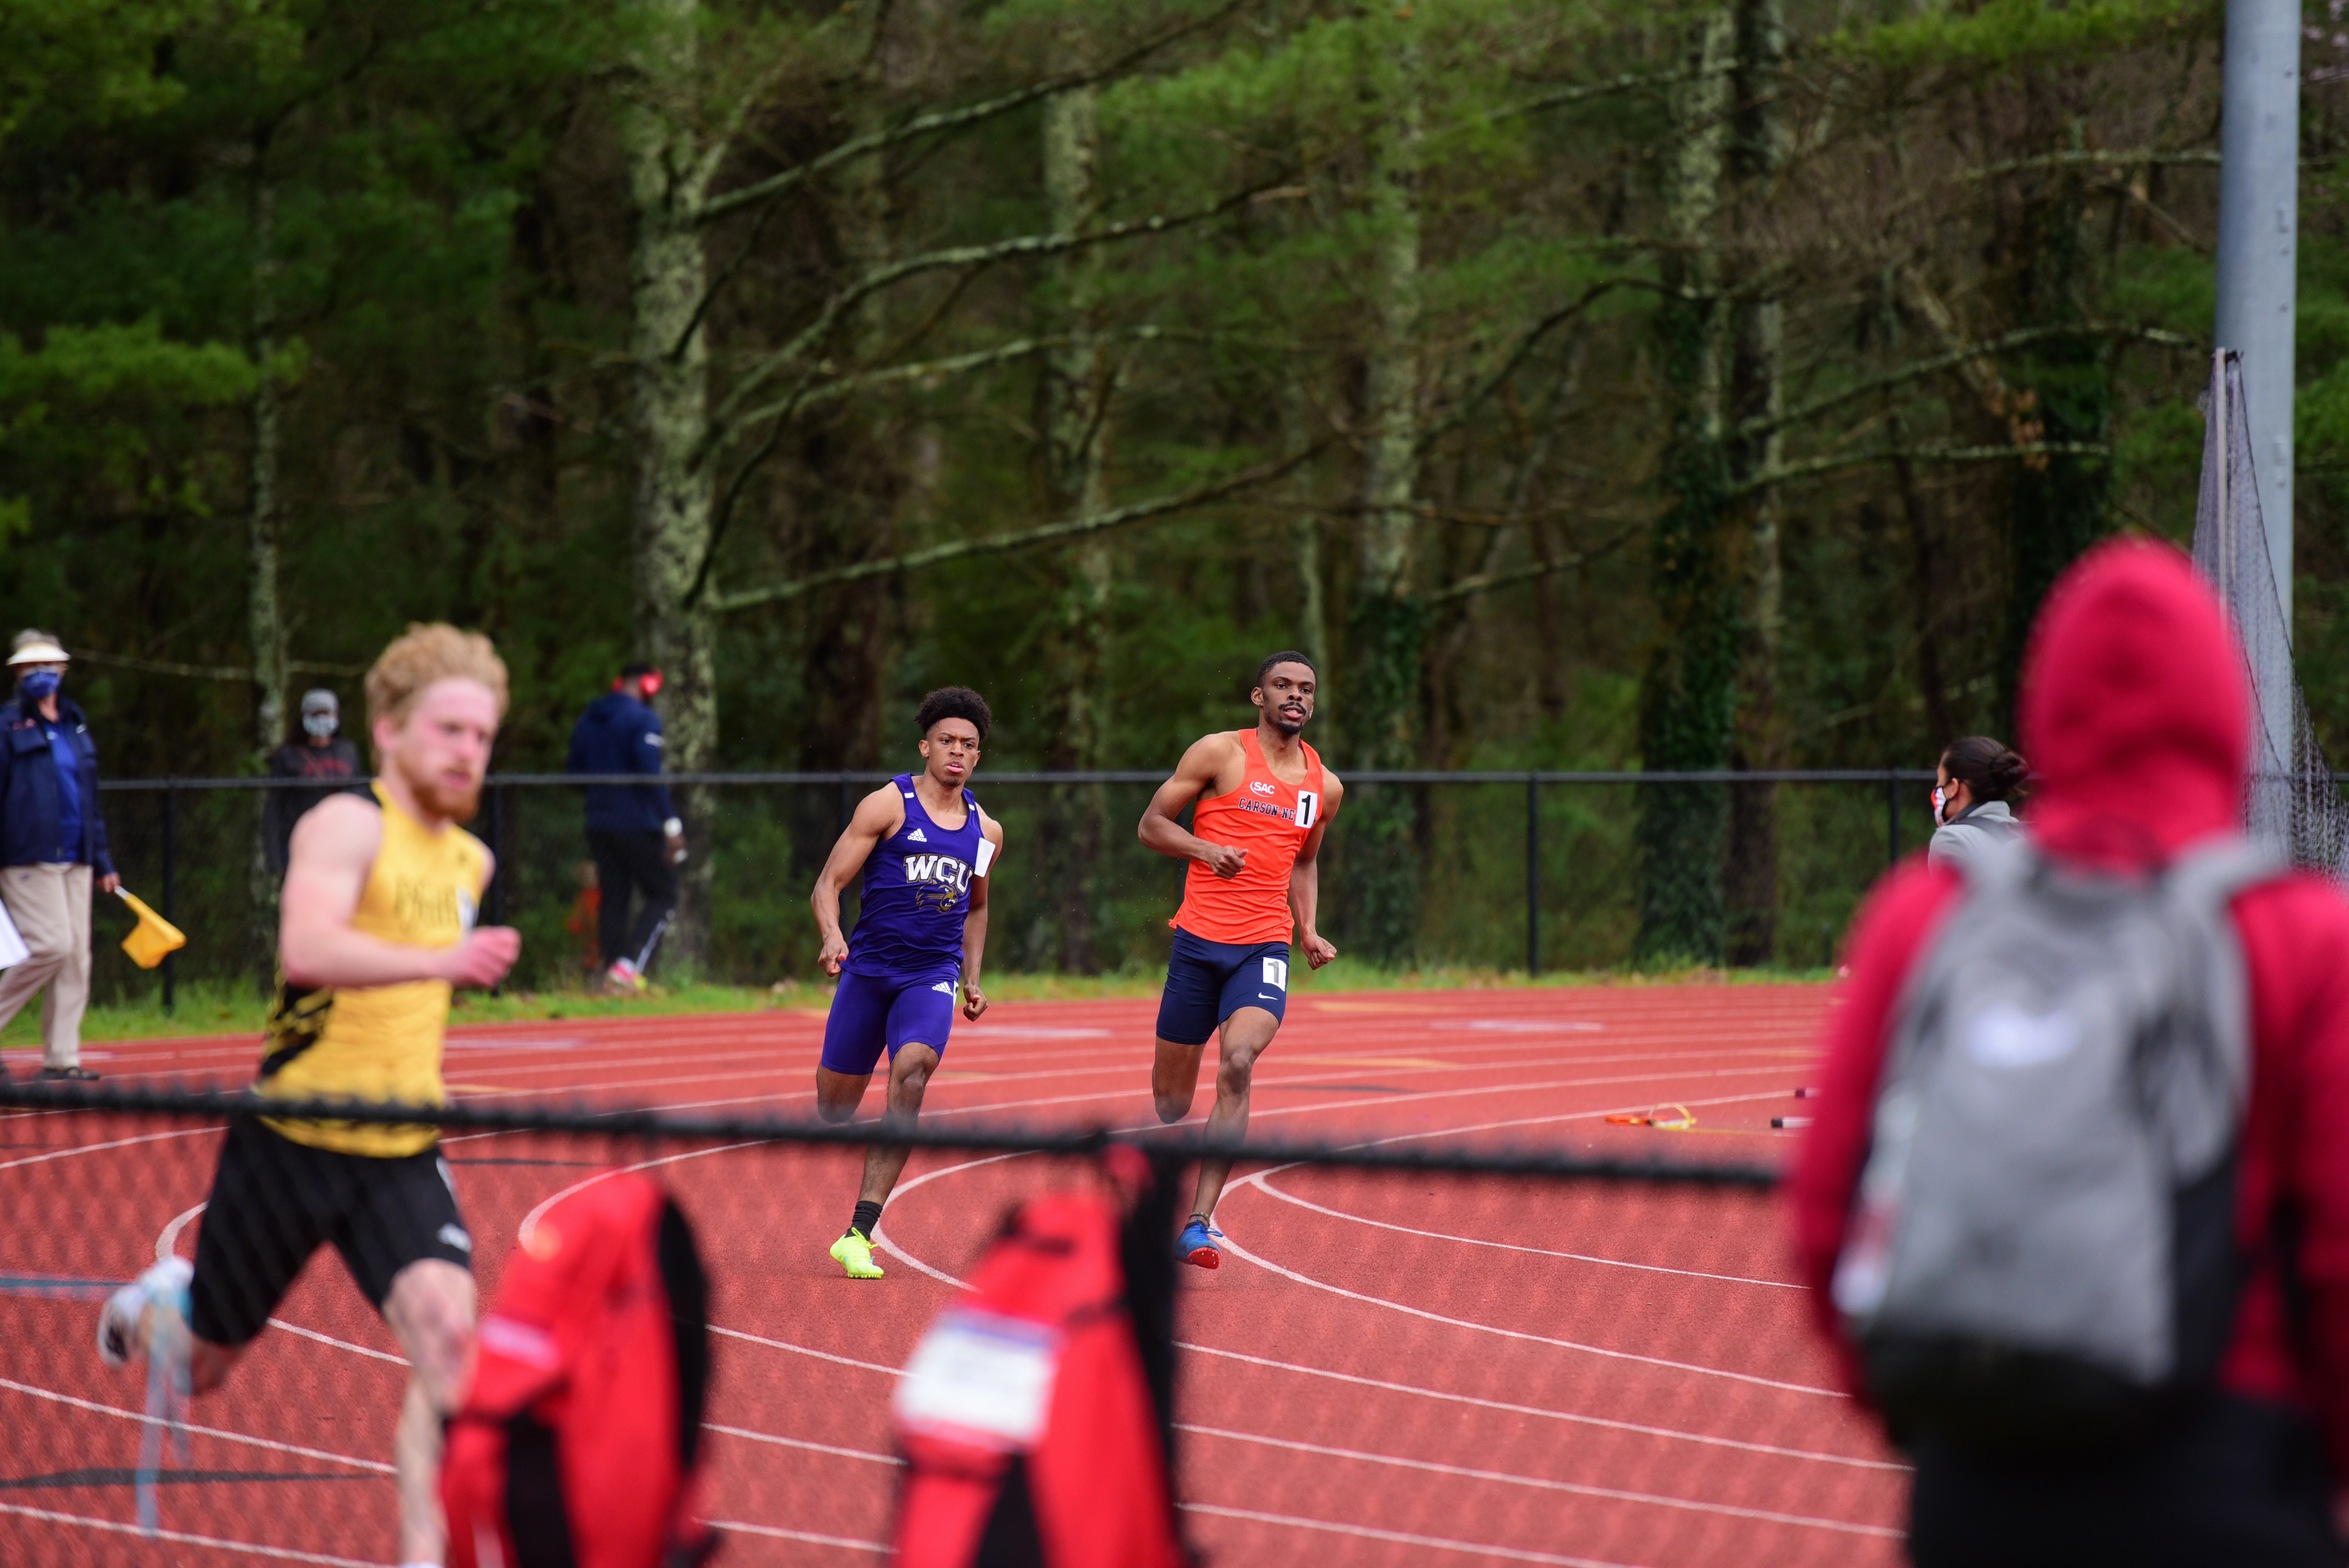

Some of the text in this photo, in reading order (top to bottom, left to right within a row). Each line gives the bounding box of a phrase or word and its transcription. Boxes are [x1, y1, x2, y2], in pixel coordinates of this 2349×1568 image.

[1253, 781, 1275, 795] SAC
[1238, 797, 1317, 824] CARSON-NE
[1301, 794, 1311, 825] 1
[904, 854, 973, 894] WCU
[1267, 960, 1280, 984] 1
